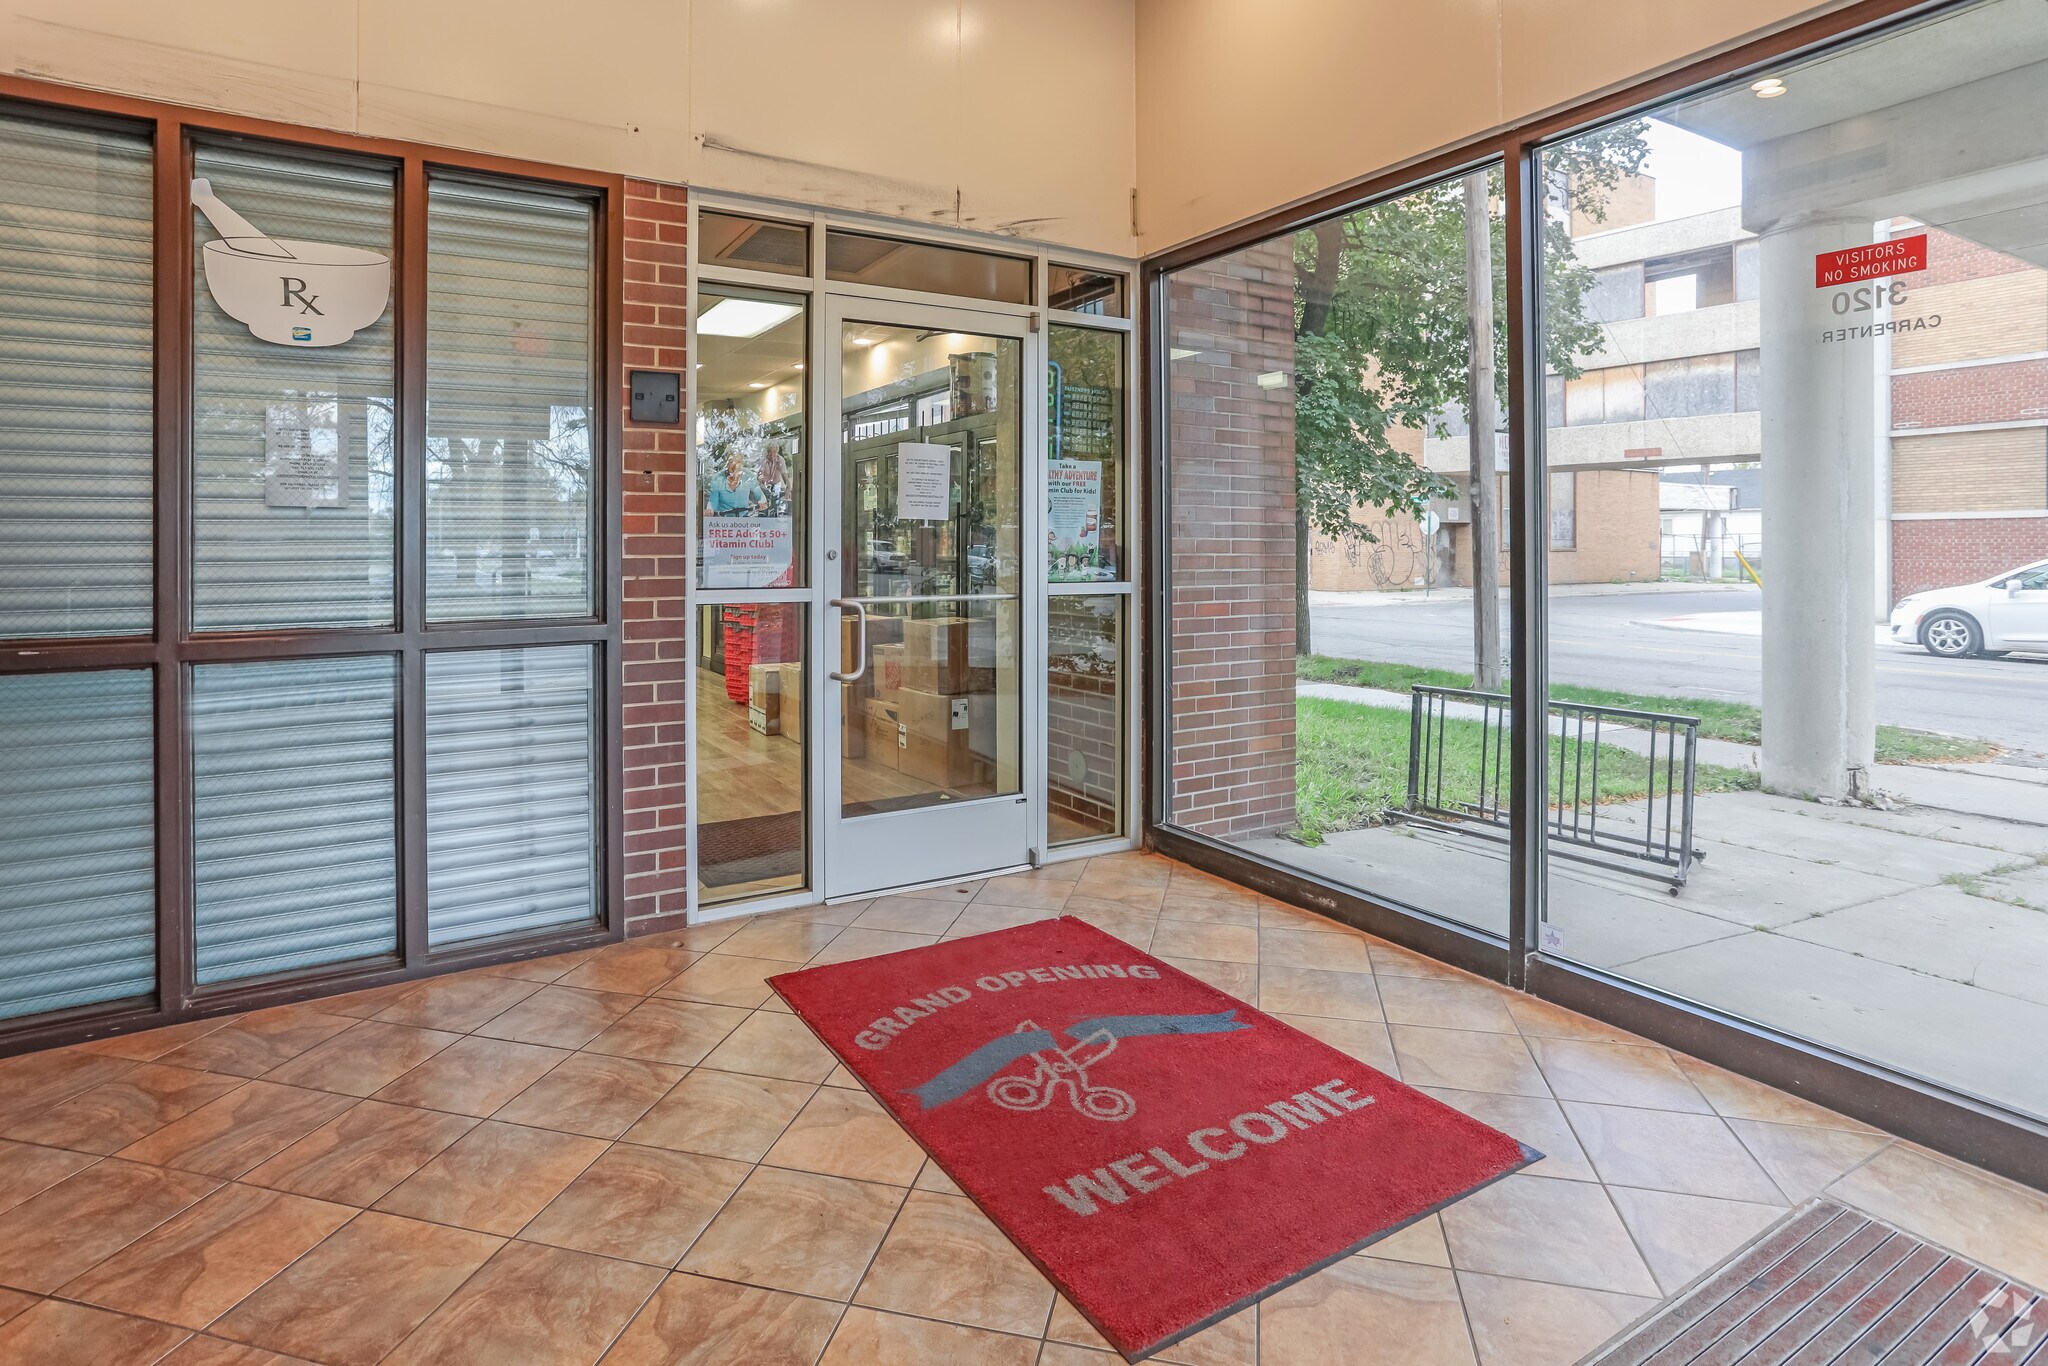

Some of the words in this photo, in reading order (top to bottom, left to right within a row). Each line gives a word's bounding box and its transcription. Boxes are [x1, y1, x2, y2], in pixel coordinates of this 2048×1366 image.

[1836, 243, 1905, 266] VISITORS
[1824, 270, 1843, 283] NO
[1850, 256, 1917, 278] SMOKING
[279, 276, 325, 316] Rx
[1064, 470, 1098, 481] ADVENTURE
[708, 529, 733, 538] FREE
[769, 530, 787, 538] 50+
[709, 539, 747, 548] Vitamin
[749, 539, 774, 548] Club!
[854, 985, 972, 1050] GRAND
[976, 964, 1161, 992] OPENING
[1042, 1078, 1375, 1216] WELCOME
